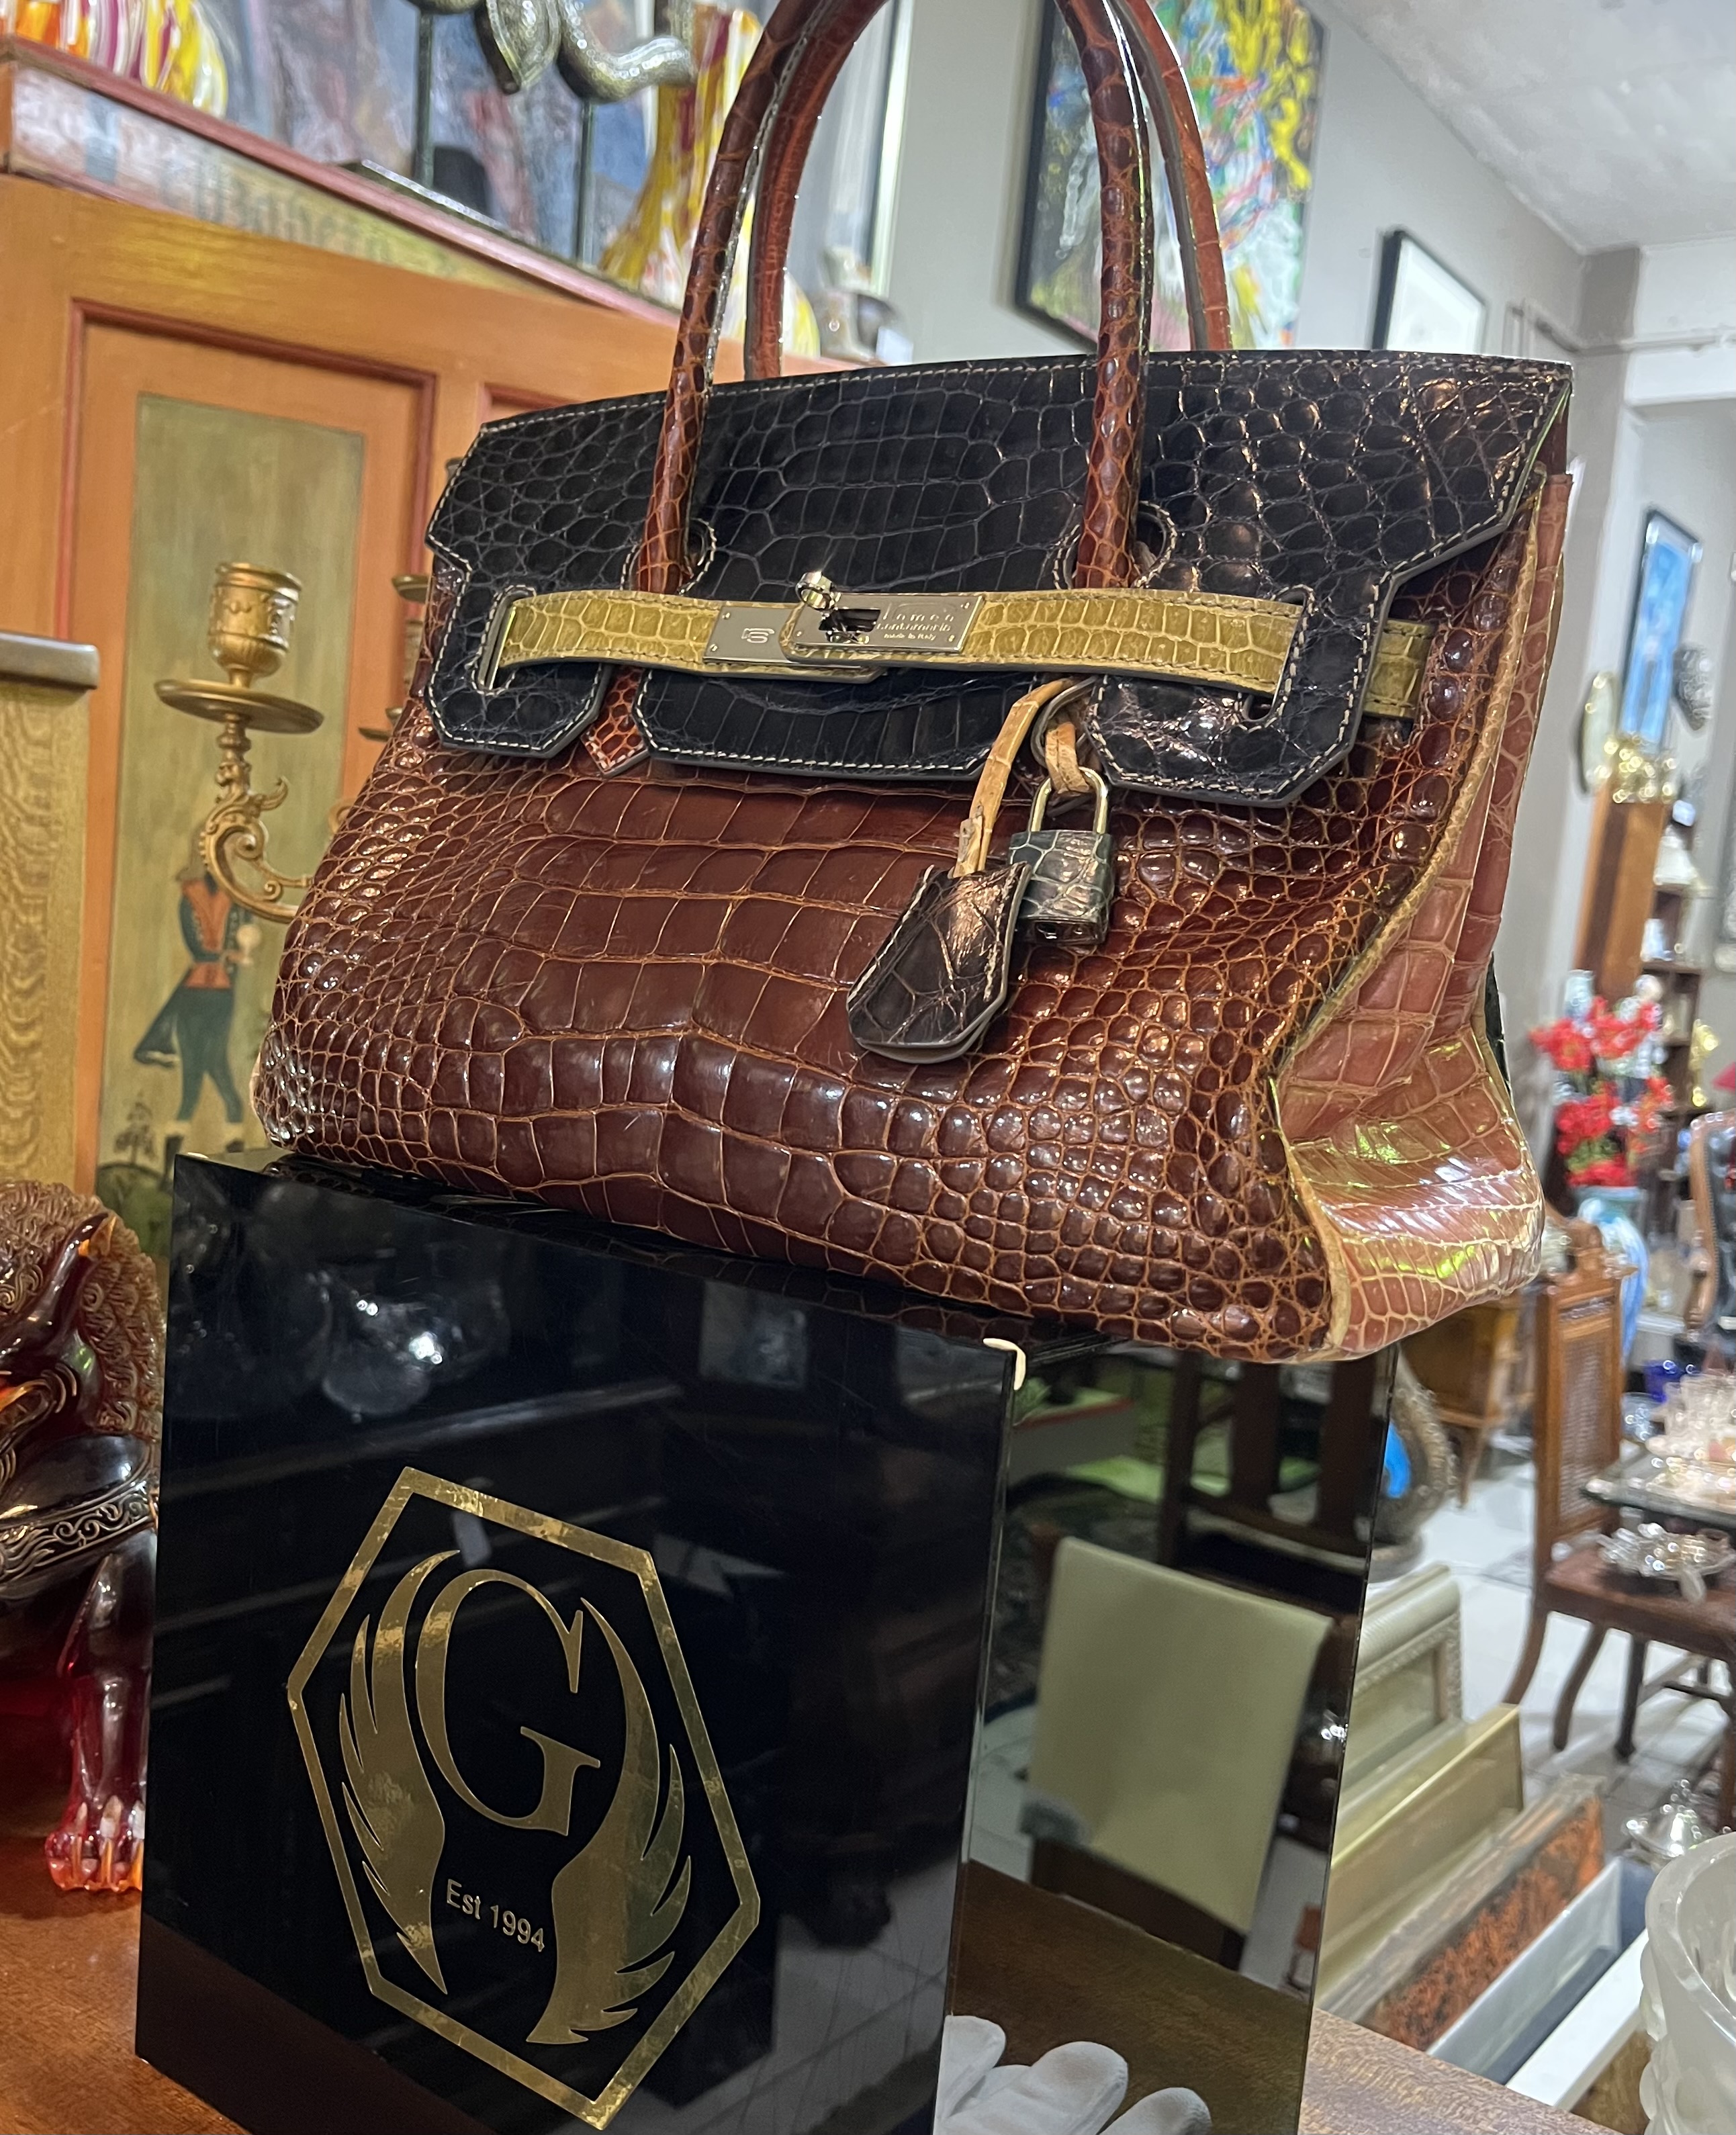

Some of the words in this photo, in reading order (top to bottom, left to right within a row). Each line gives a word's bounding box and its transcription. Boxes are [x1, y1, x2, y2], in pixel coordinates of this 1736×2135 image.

[416, 1569, 600, 1836] G
[447, 1878, 481, 1919] Est
[490, 1905, 545, 1952] 1994
